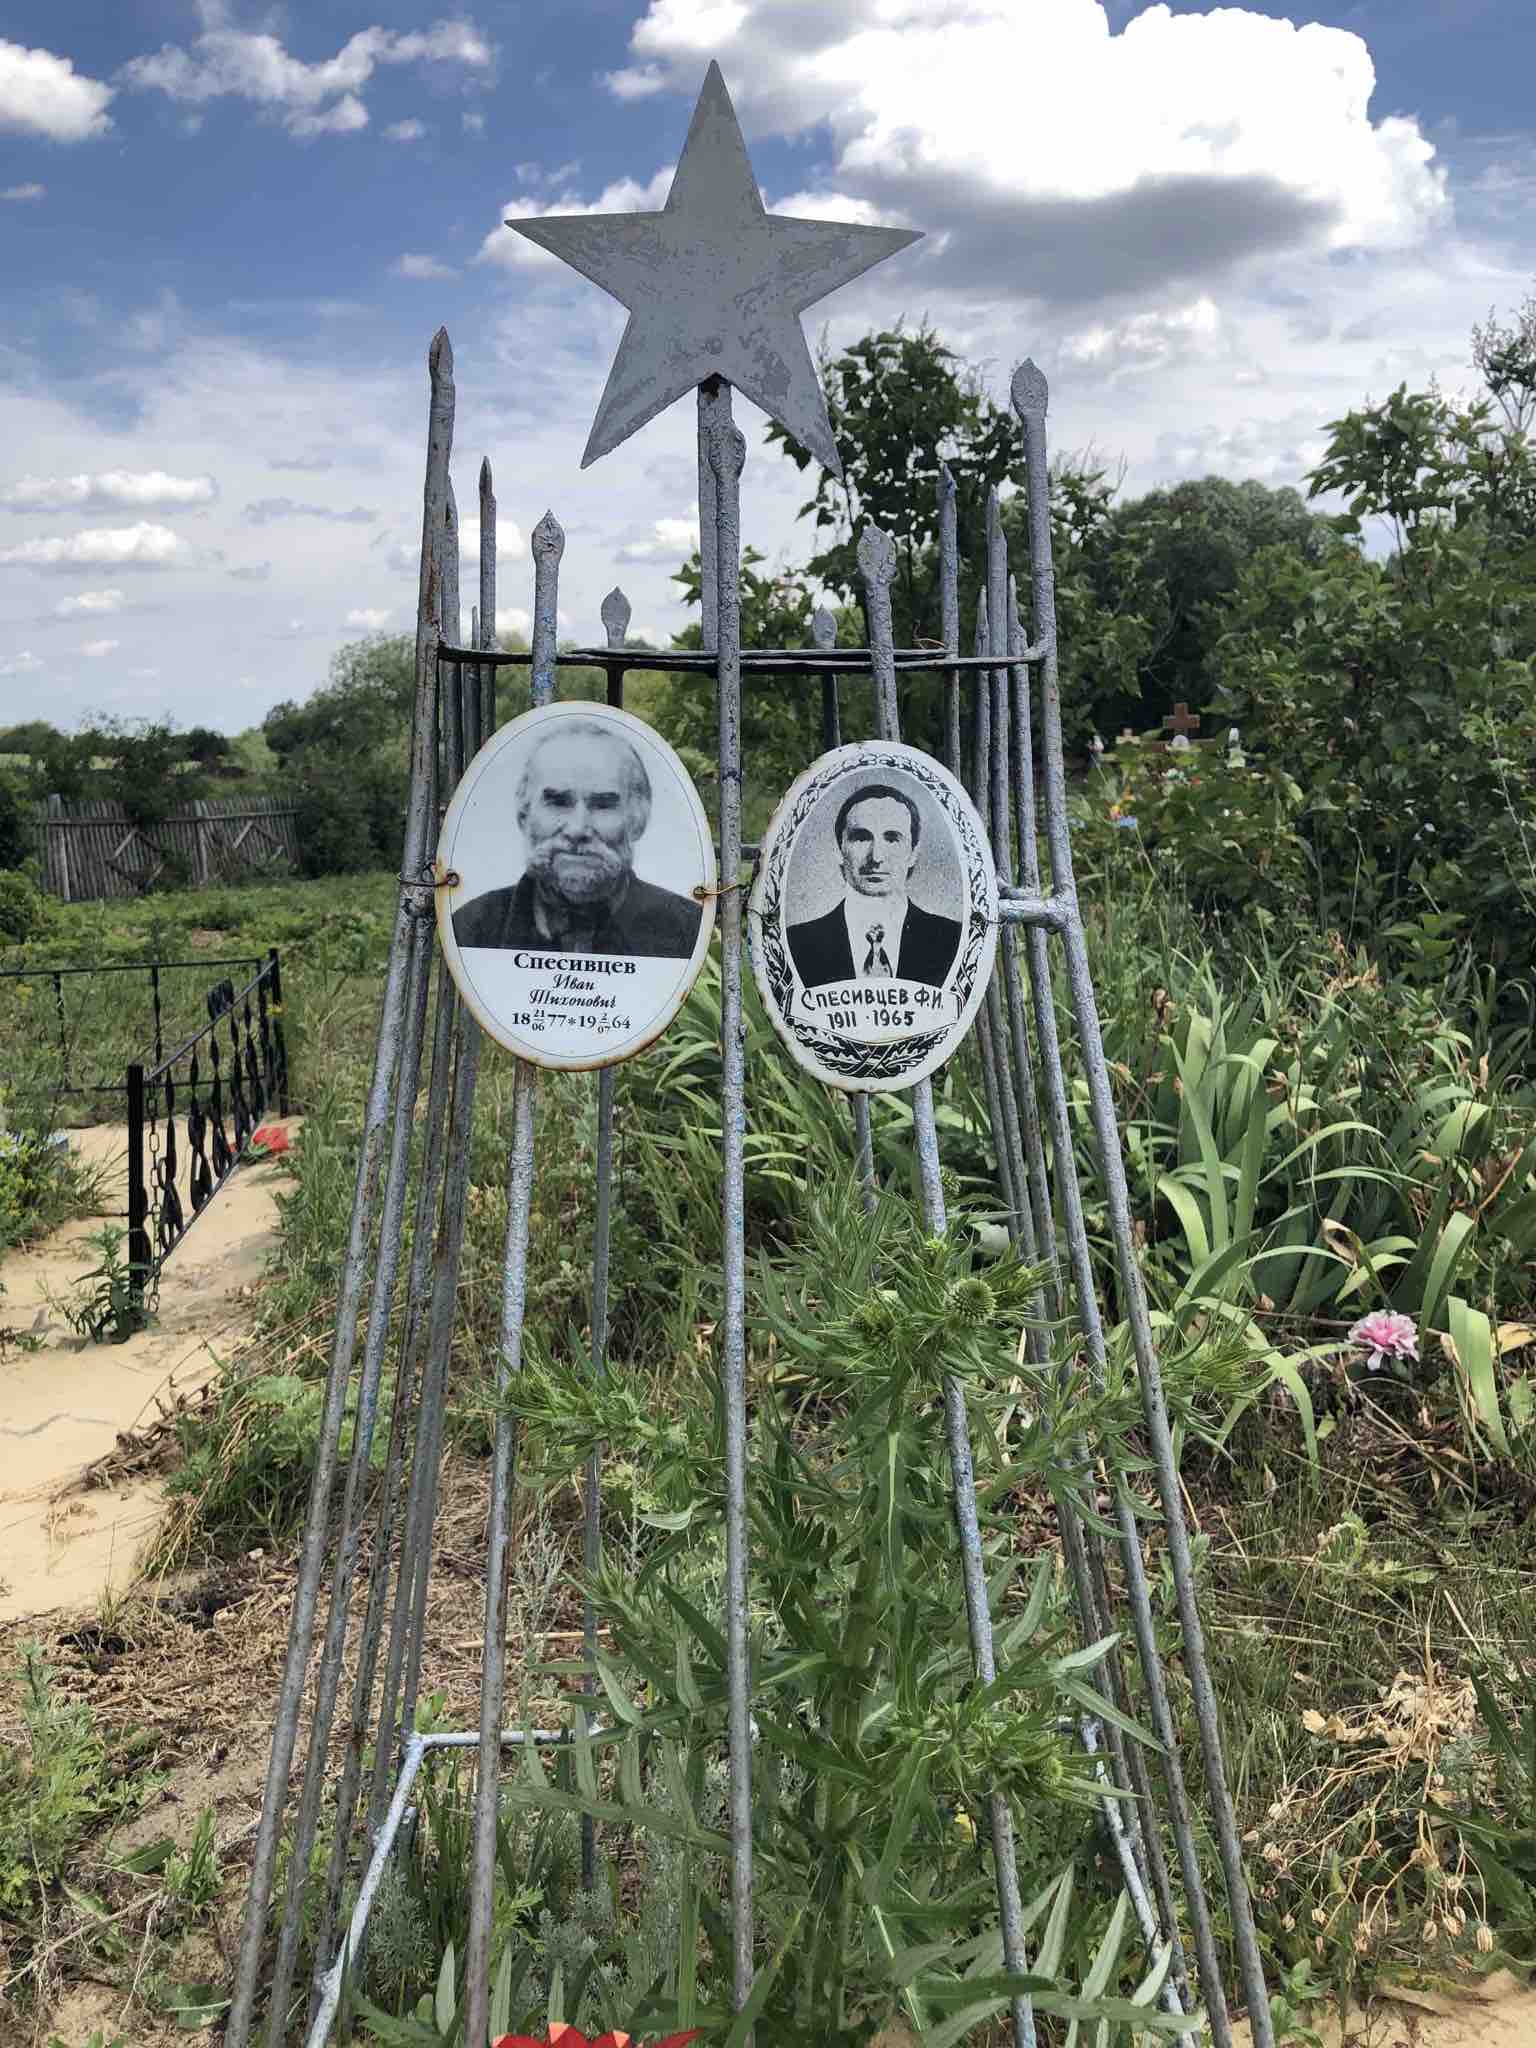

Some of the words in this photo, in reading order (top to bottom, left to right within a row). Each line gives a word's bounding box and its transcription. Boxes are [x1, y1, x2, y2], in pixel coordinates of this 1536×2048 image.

[514, 952, 636, 975] Спесивцев
[552, 973, 595, 990] Иван
[801, 987, 909, 1010] СПЕСИВЦЕВ
